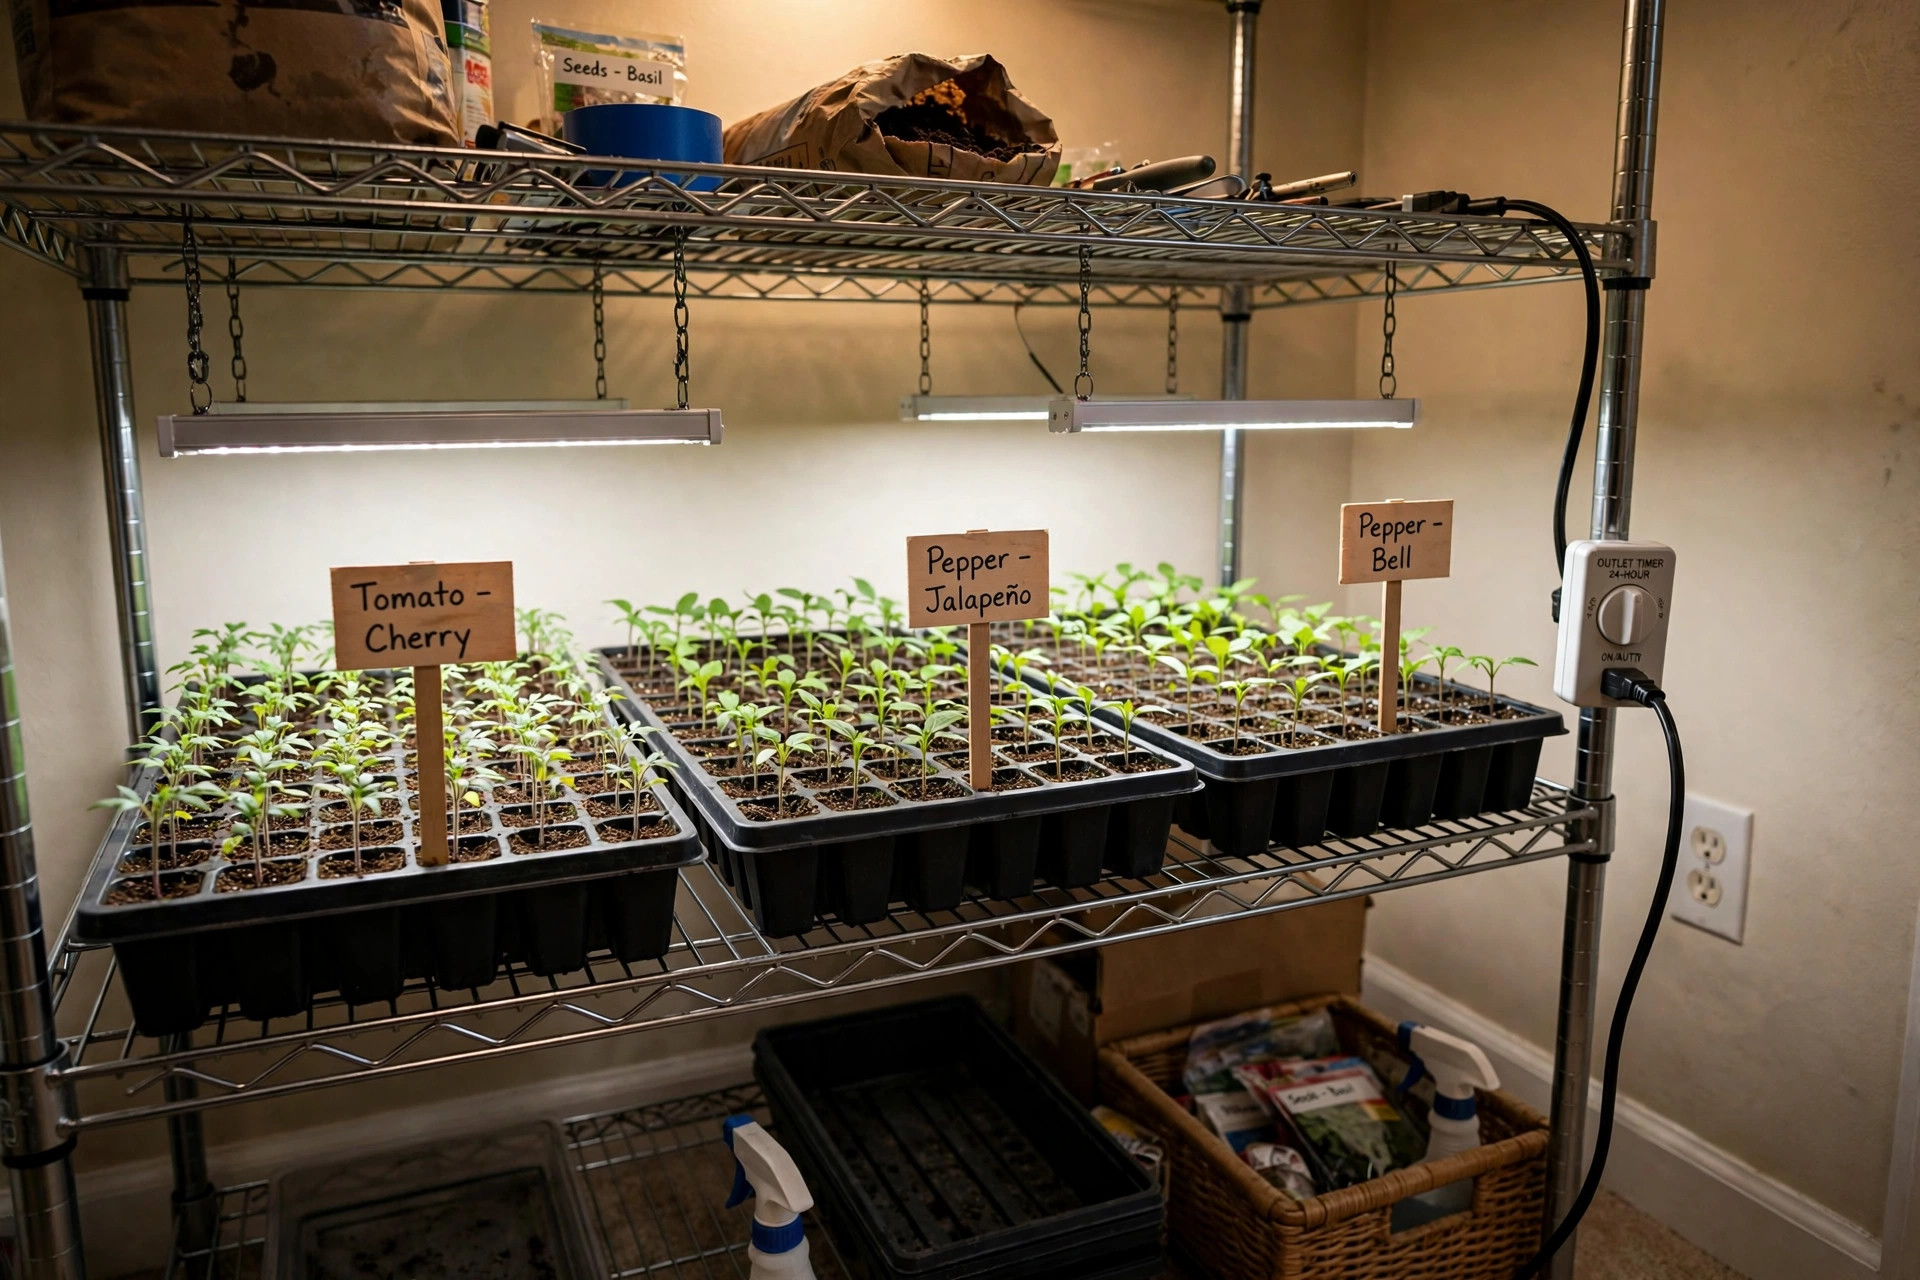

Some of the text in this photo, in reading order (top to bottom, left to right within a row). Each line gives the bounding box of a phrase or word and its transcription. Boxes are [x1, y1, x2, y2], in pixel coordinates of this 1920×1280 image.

[563, 57, 608, 78] Seeds
[627, 65, 662, 85] Basil
[1359, 512, 1427, 544] Pepper
[926, 545, 1010, 581] Pepper
[1372, 544, 1411, 572] Bell
[1597, 558, 1664, 568] OUTLET TIMER
[1609, 570, 1650, 579] 24-HOUR
[350, 580, 464, 612] Tomato
[924, 583, 1032, 618] Jalapeño
[365, 623, 471, 659] Cherry
